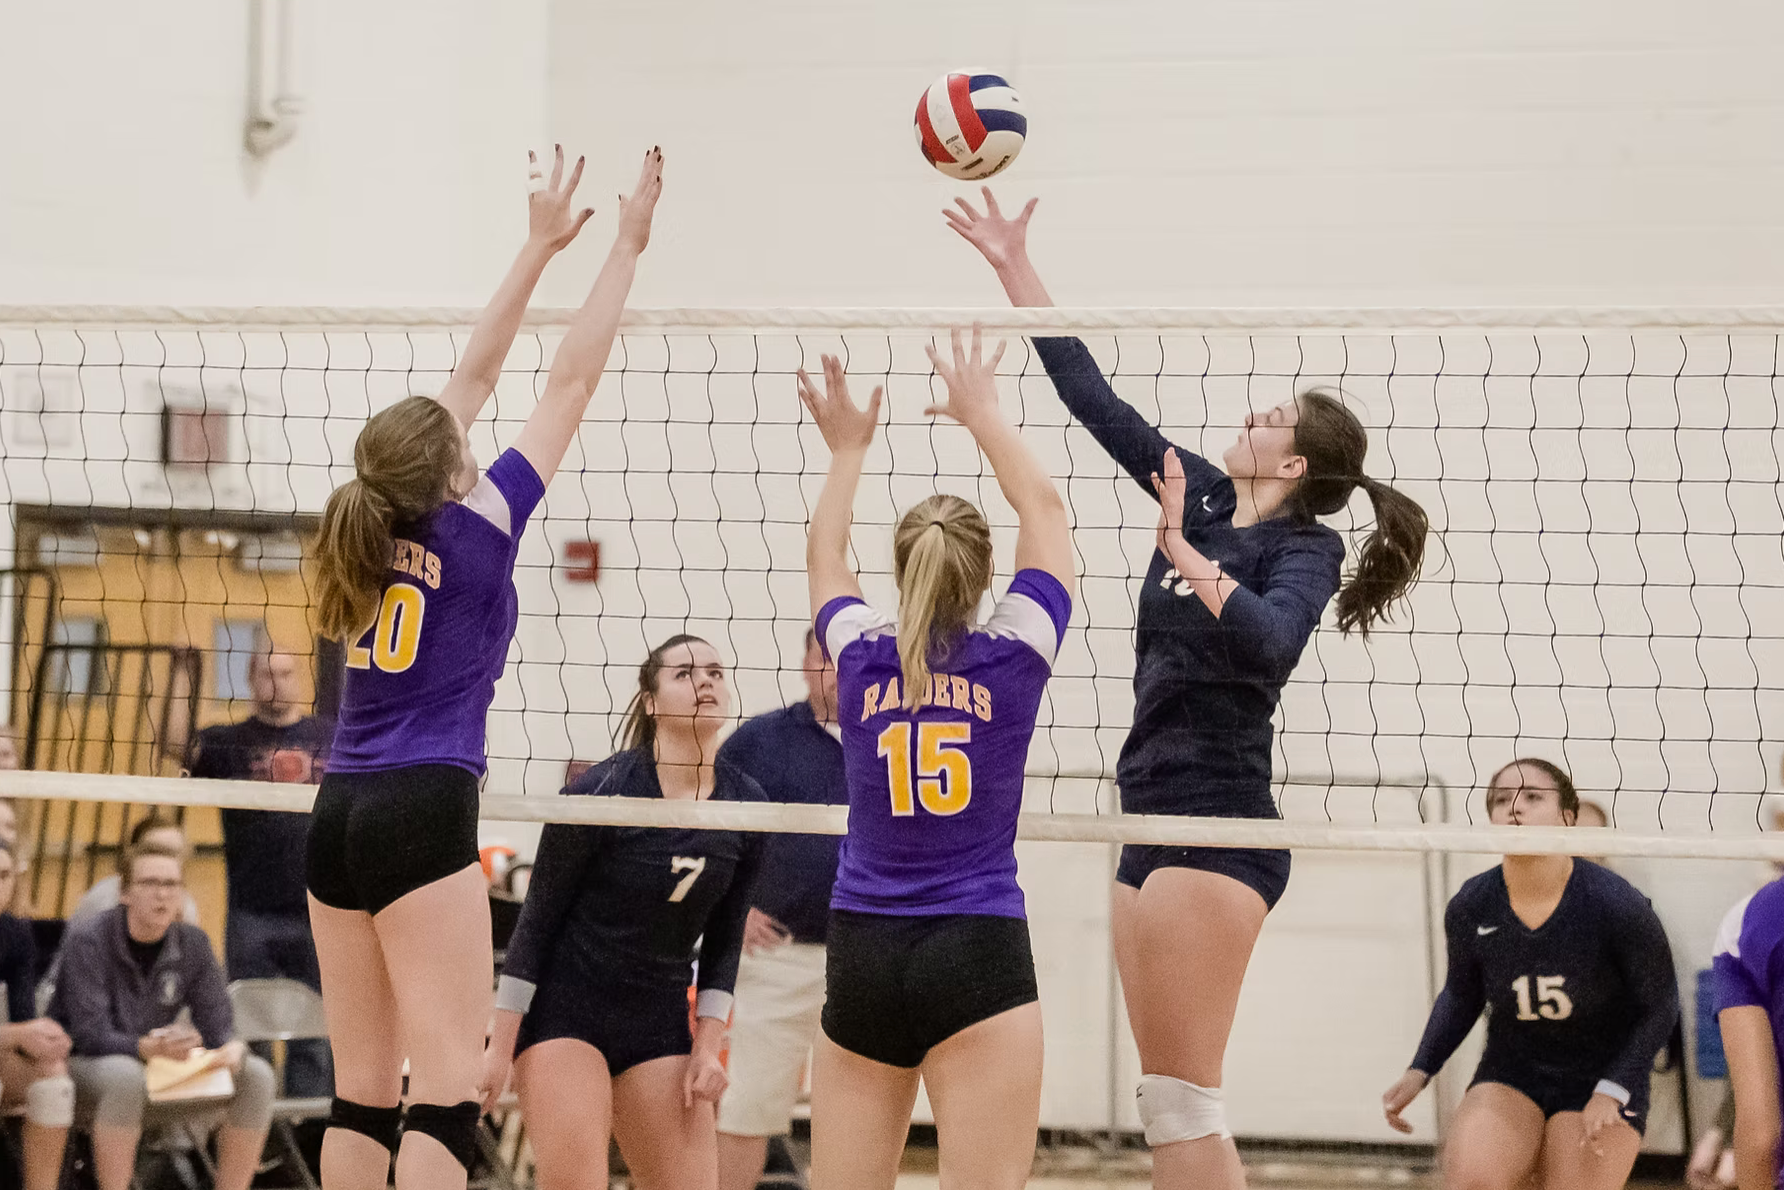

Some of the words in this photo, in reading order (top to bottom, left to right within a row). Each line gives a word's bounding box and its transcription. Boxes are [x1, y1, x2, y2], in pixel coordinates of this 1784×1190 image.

[877, 721, 972, 816] 15
[667, 856, 706, 903] 7
[1511, 975, 1573, 1021] 15
